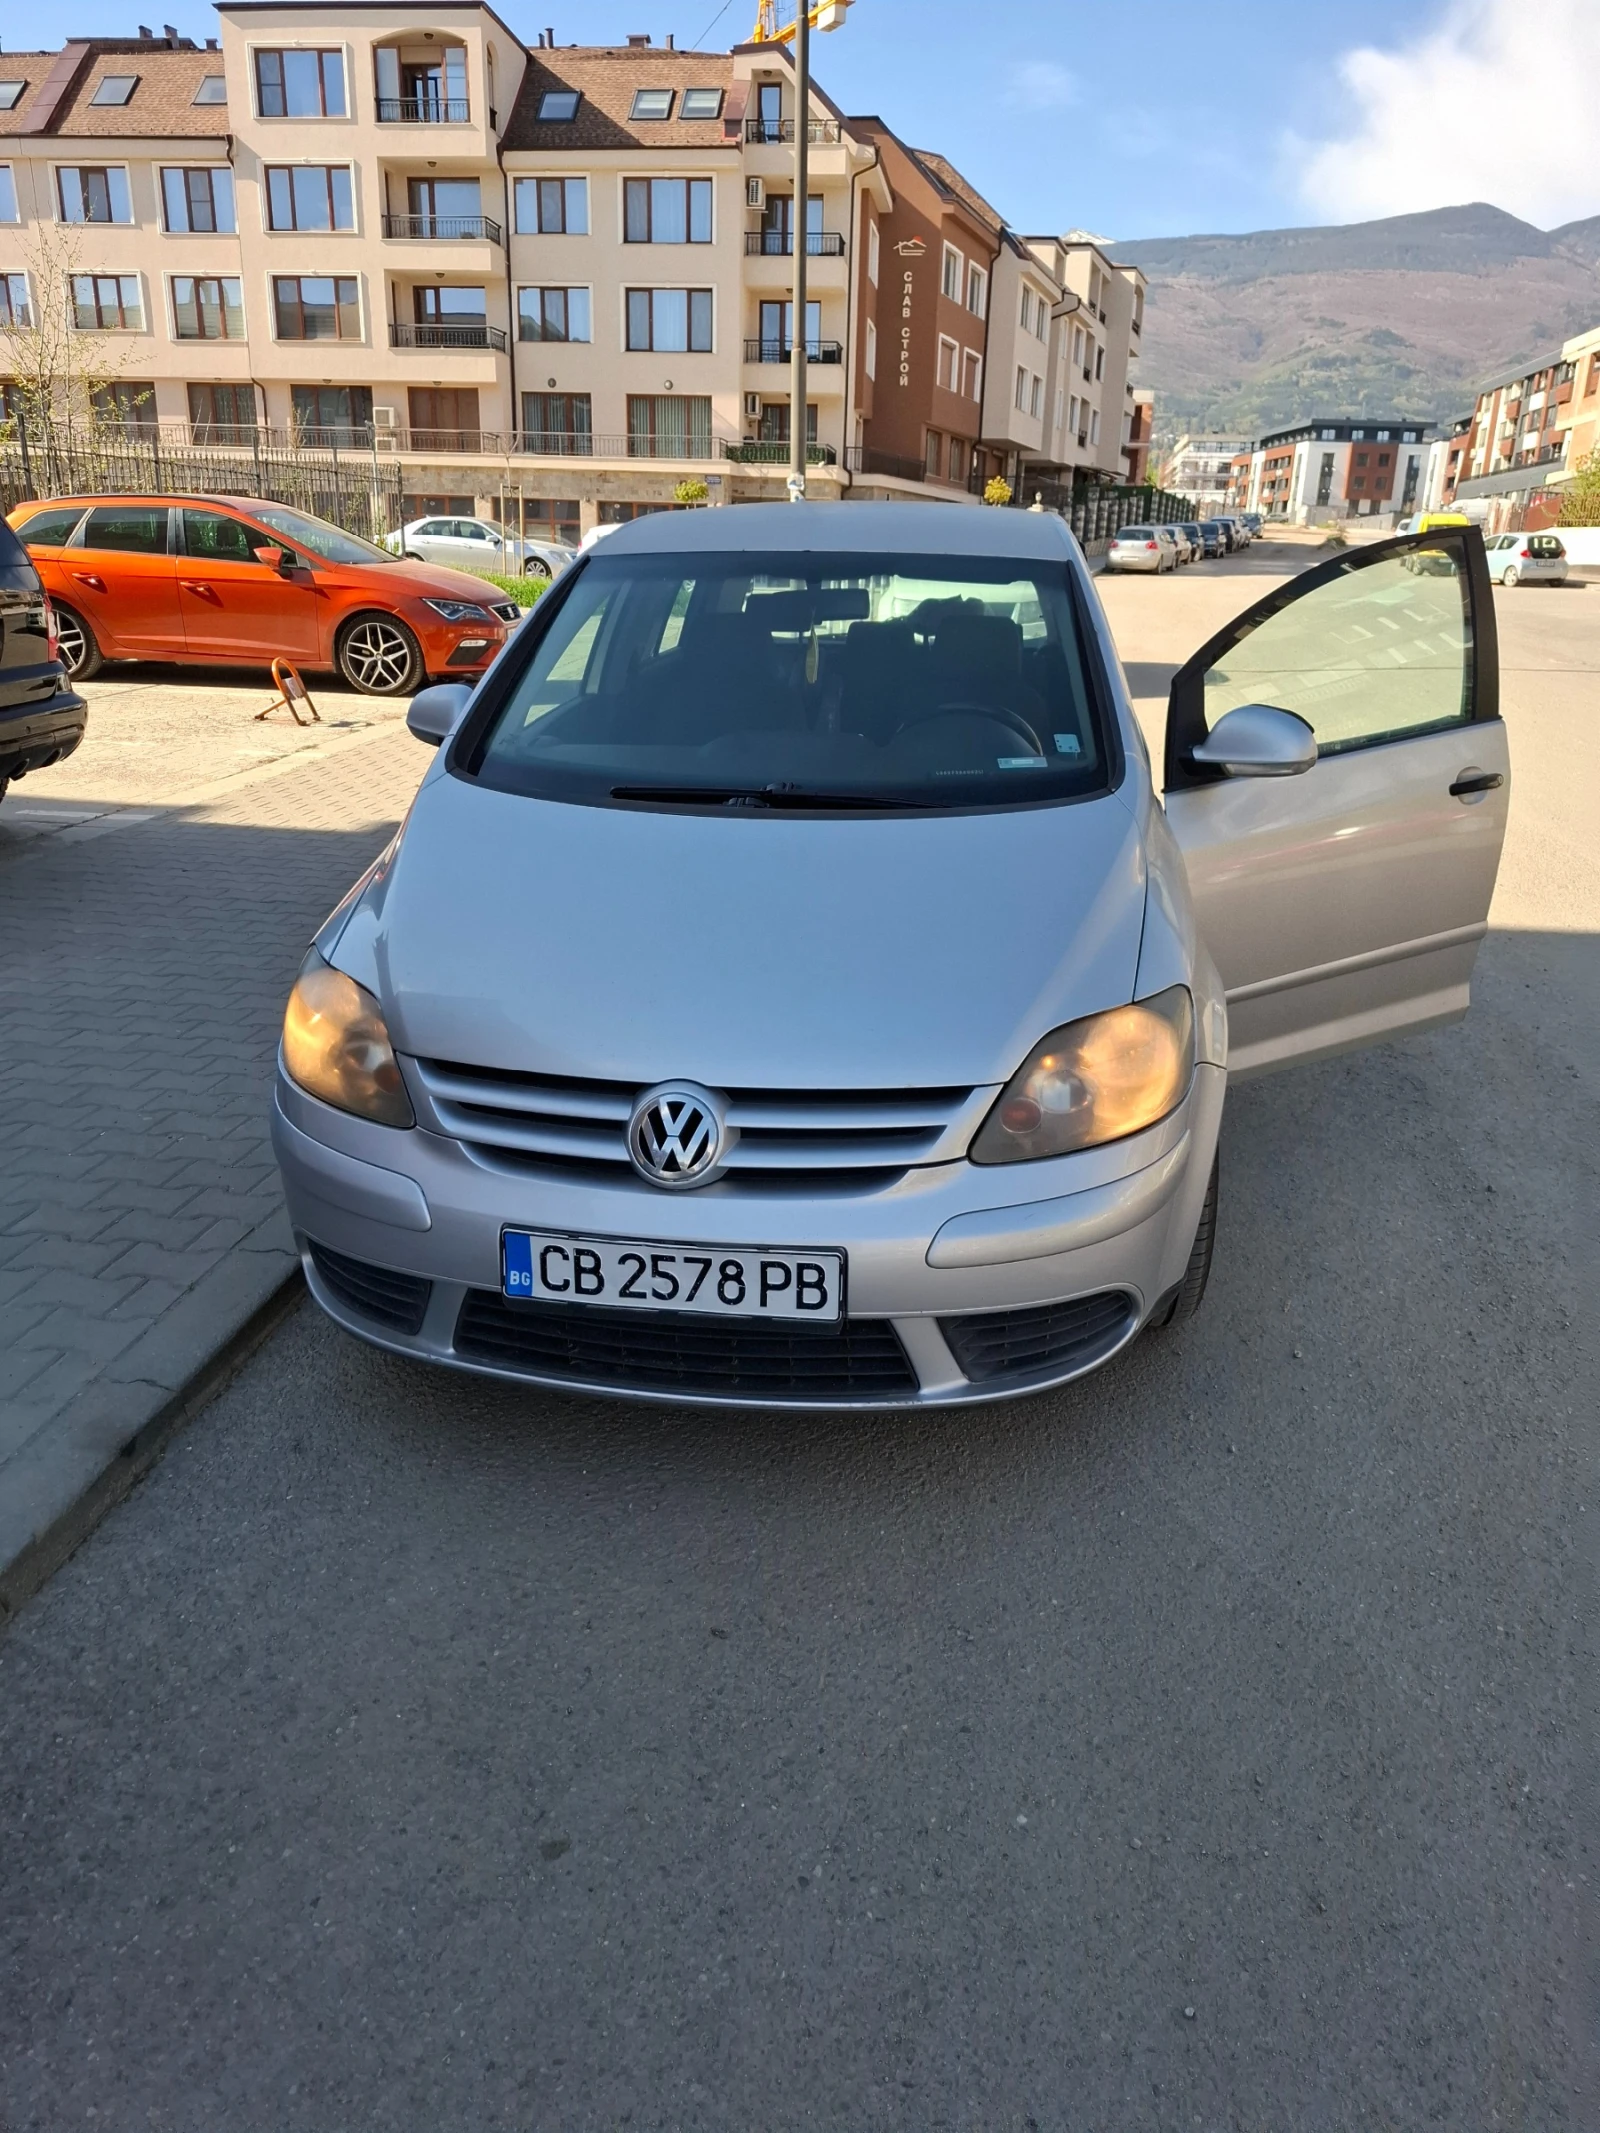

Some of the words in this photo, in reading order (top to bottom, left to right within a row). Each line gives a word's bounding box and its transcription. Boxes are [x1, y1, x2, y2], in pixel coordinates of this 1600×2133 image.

[902, 271, 913, 318] СЛАВ
[899, 327, 911, 386] СТРОЙ
[635, 1096, 715, 1177] VW
[509, 1270, 531, 1286] BG
[539, 1244, 605, 1296] CB
[617, 1252, 747, 1306] 2578
[759, 1261, 828, 1311] PB
